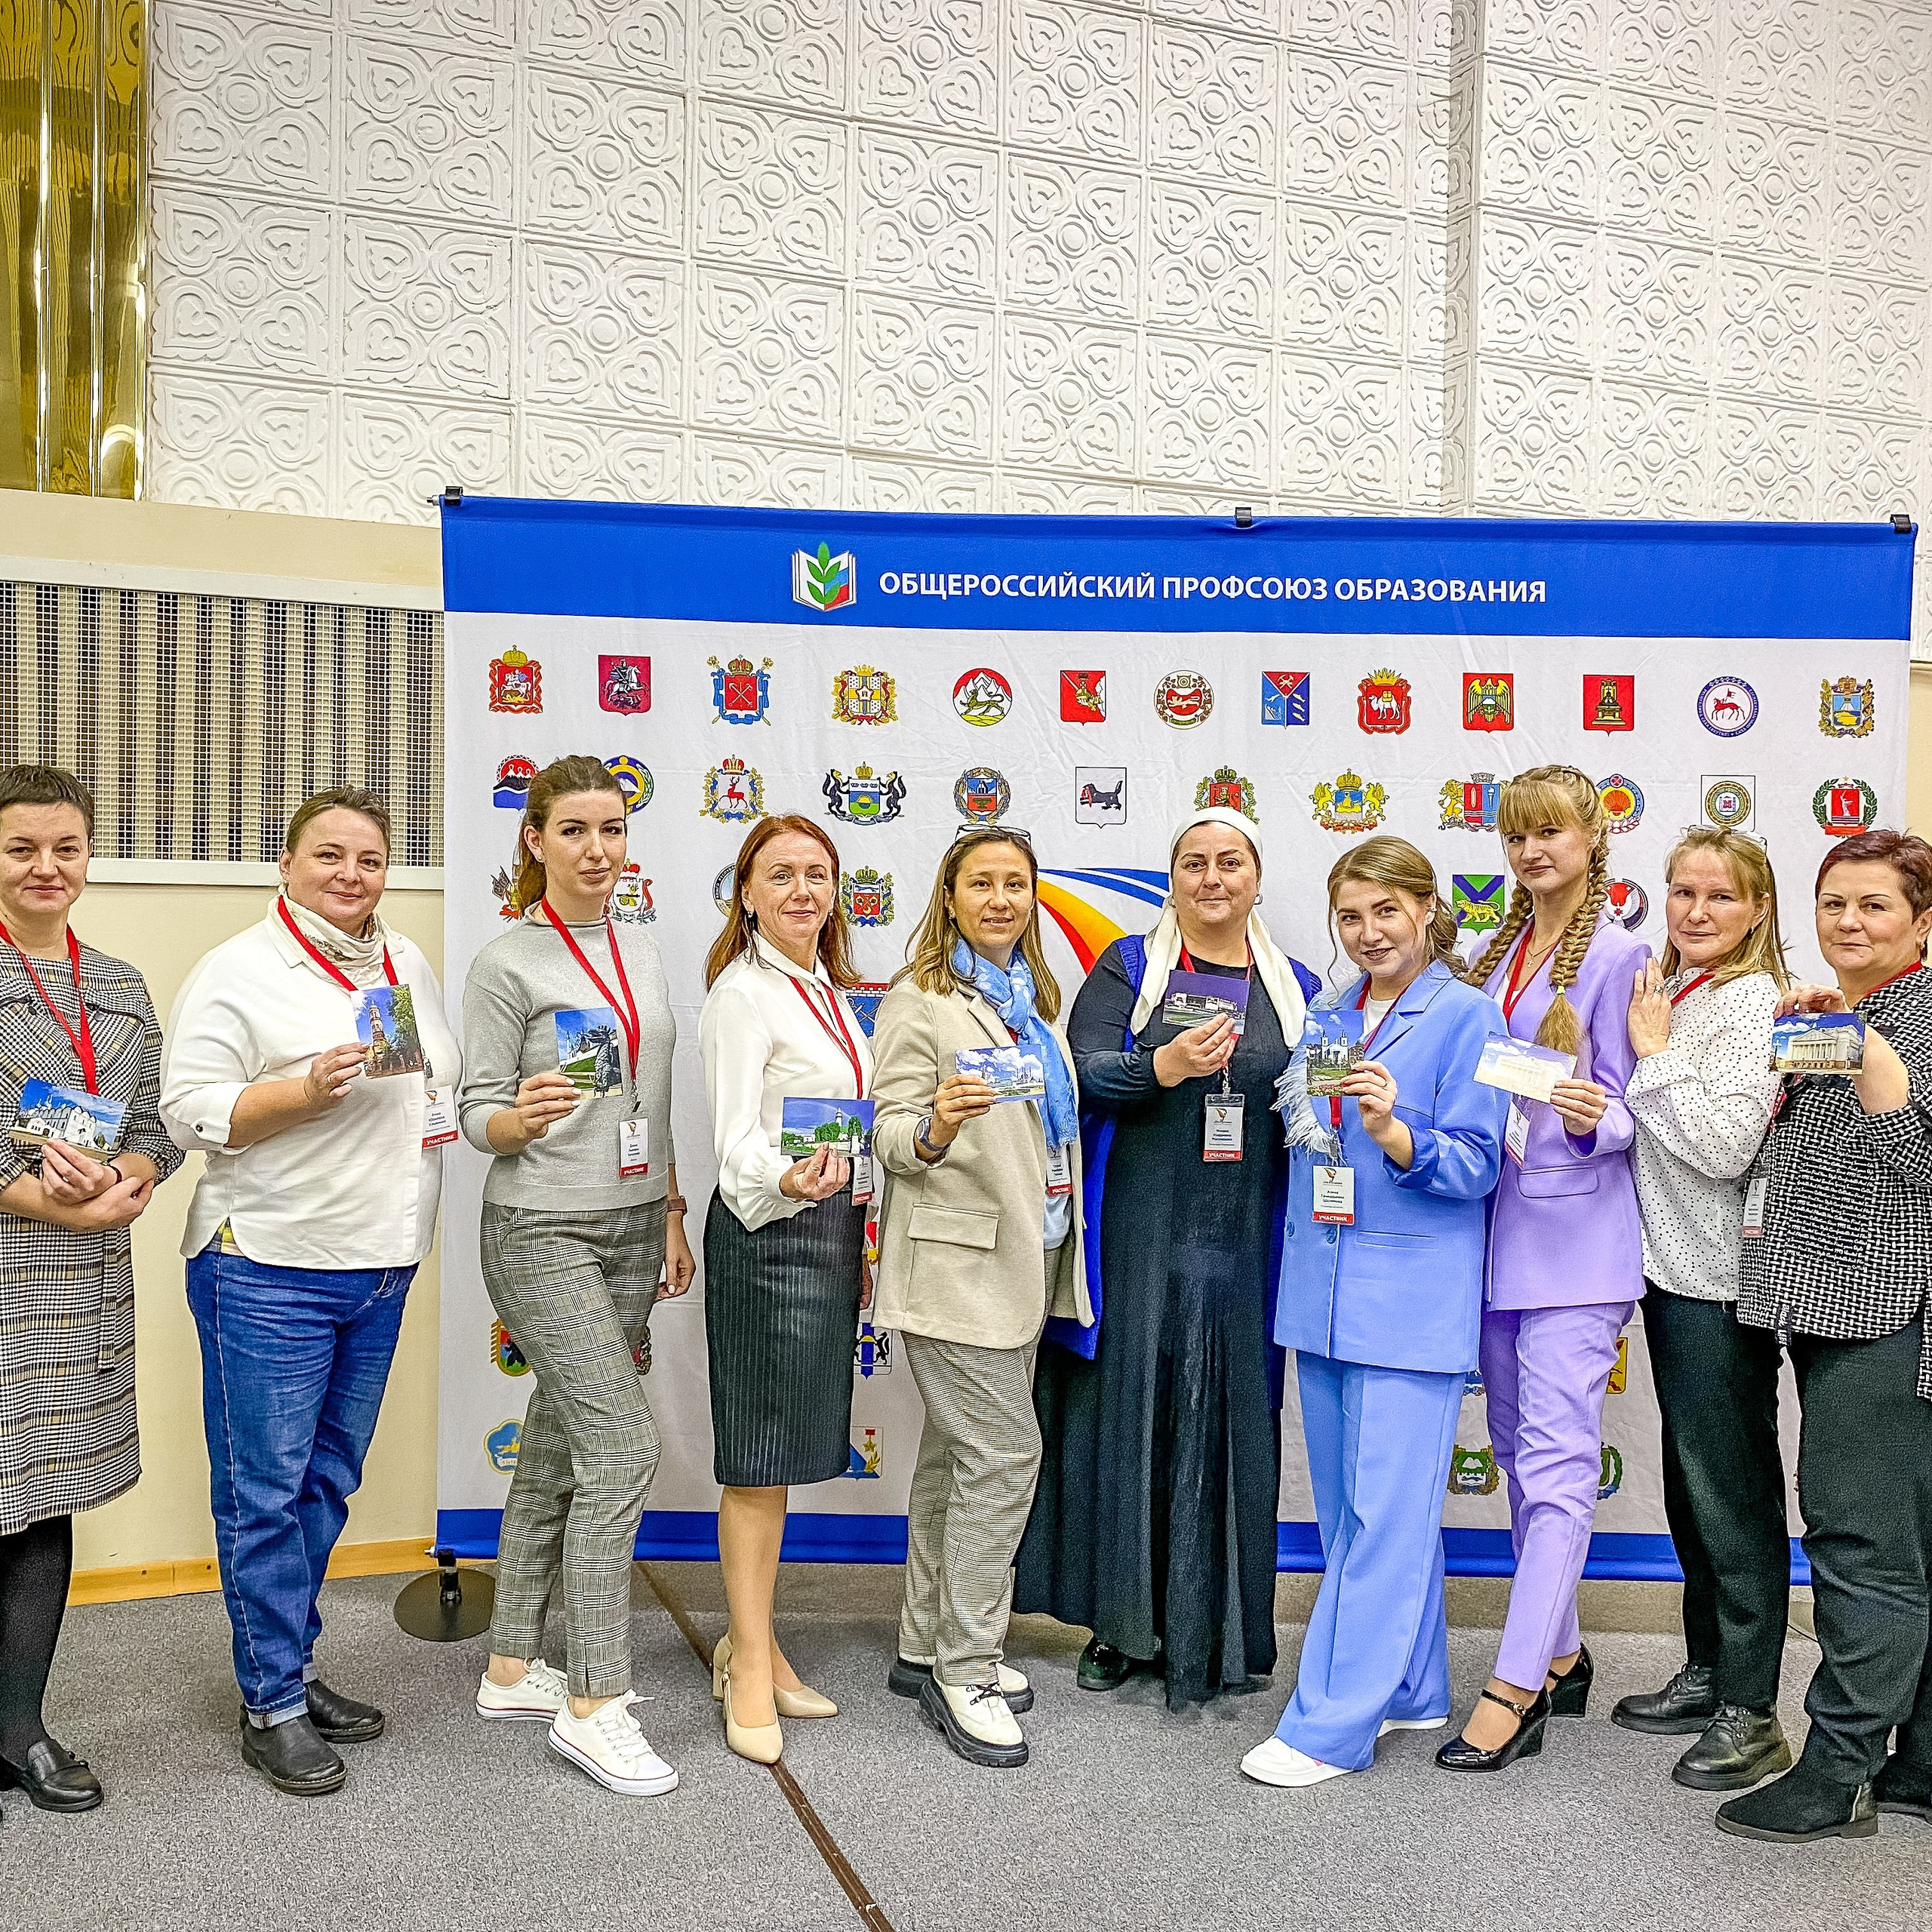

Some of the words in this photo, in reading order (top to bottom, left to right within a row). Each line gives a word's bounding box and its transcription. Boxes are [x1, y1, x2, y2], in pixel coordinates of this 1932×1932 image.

[879, 571, 1155, 601] ОБЩЕРОССИЙСКИЙ
[1163, 575, 1327, 600] ПРОФСОЮЗ
[1334, 578, 1546, 602] ОБРАЗОВАНИЯ
[426, 1134, 455, 1145] УЧАСТНИК
